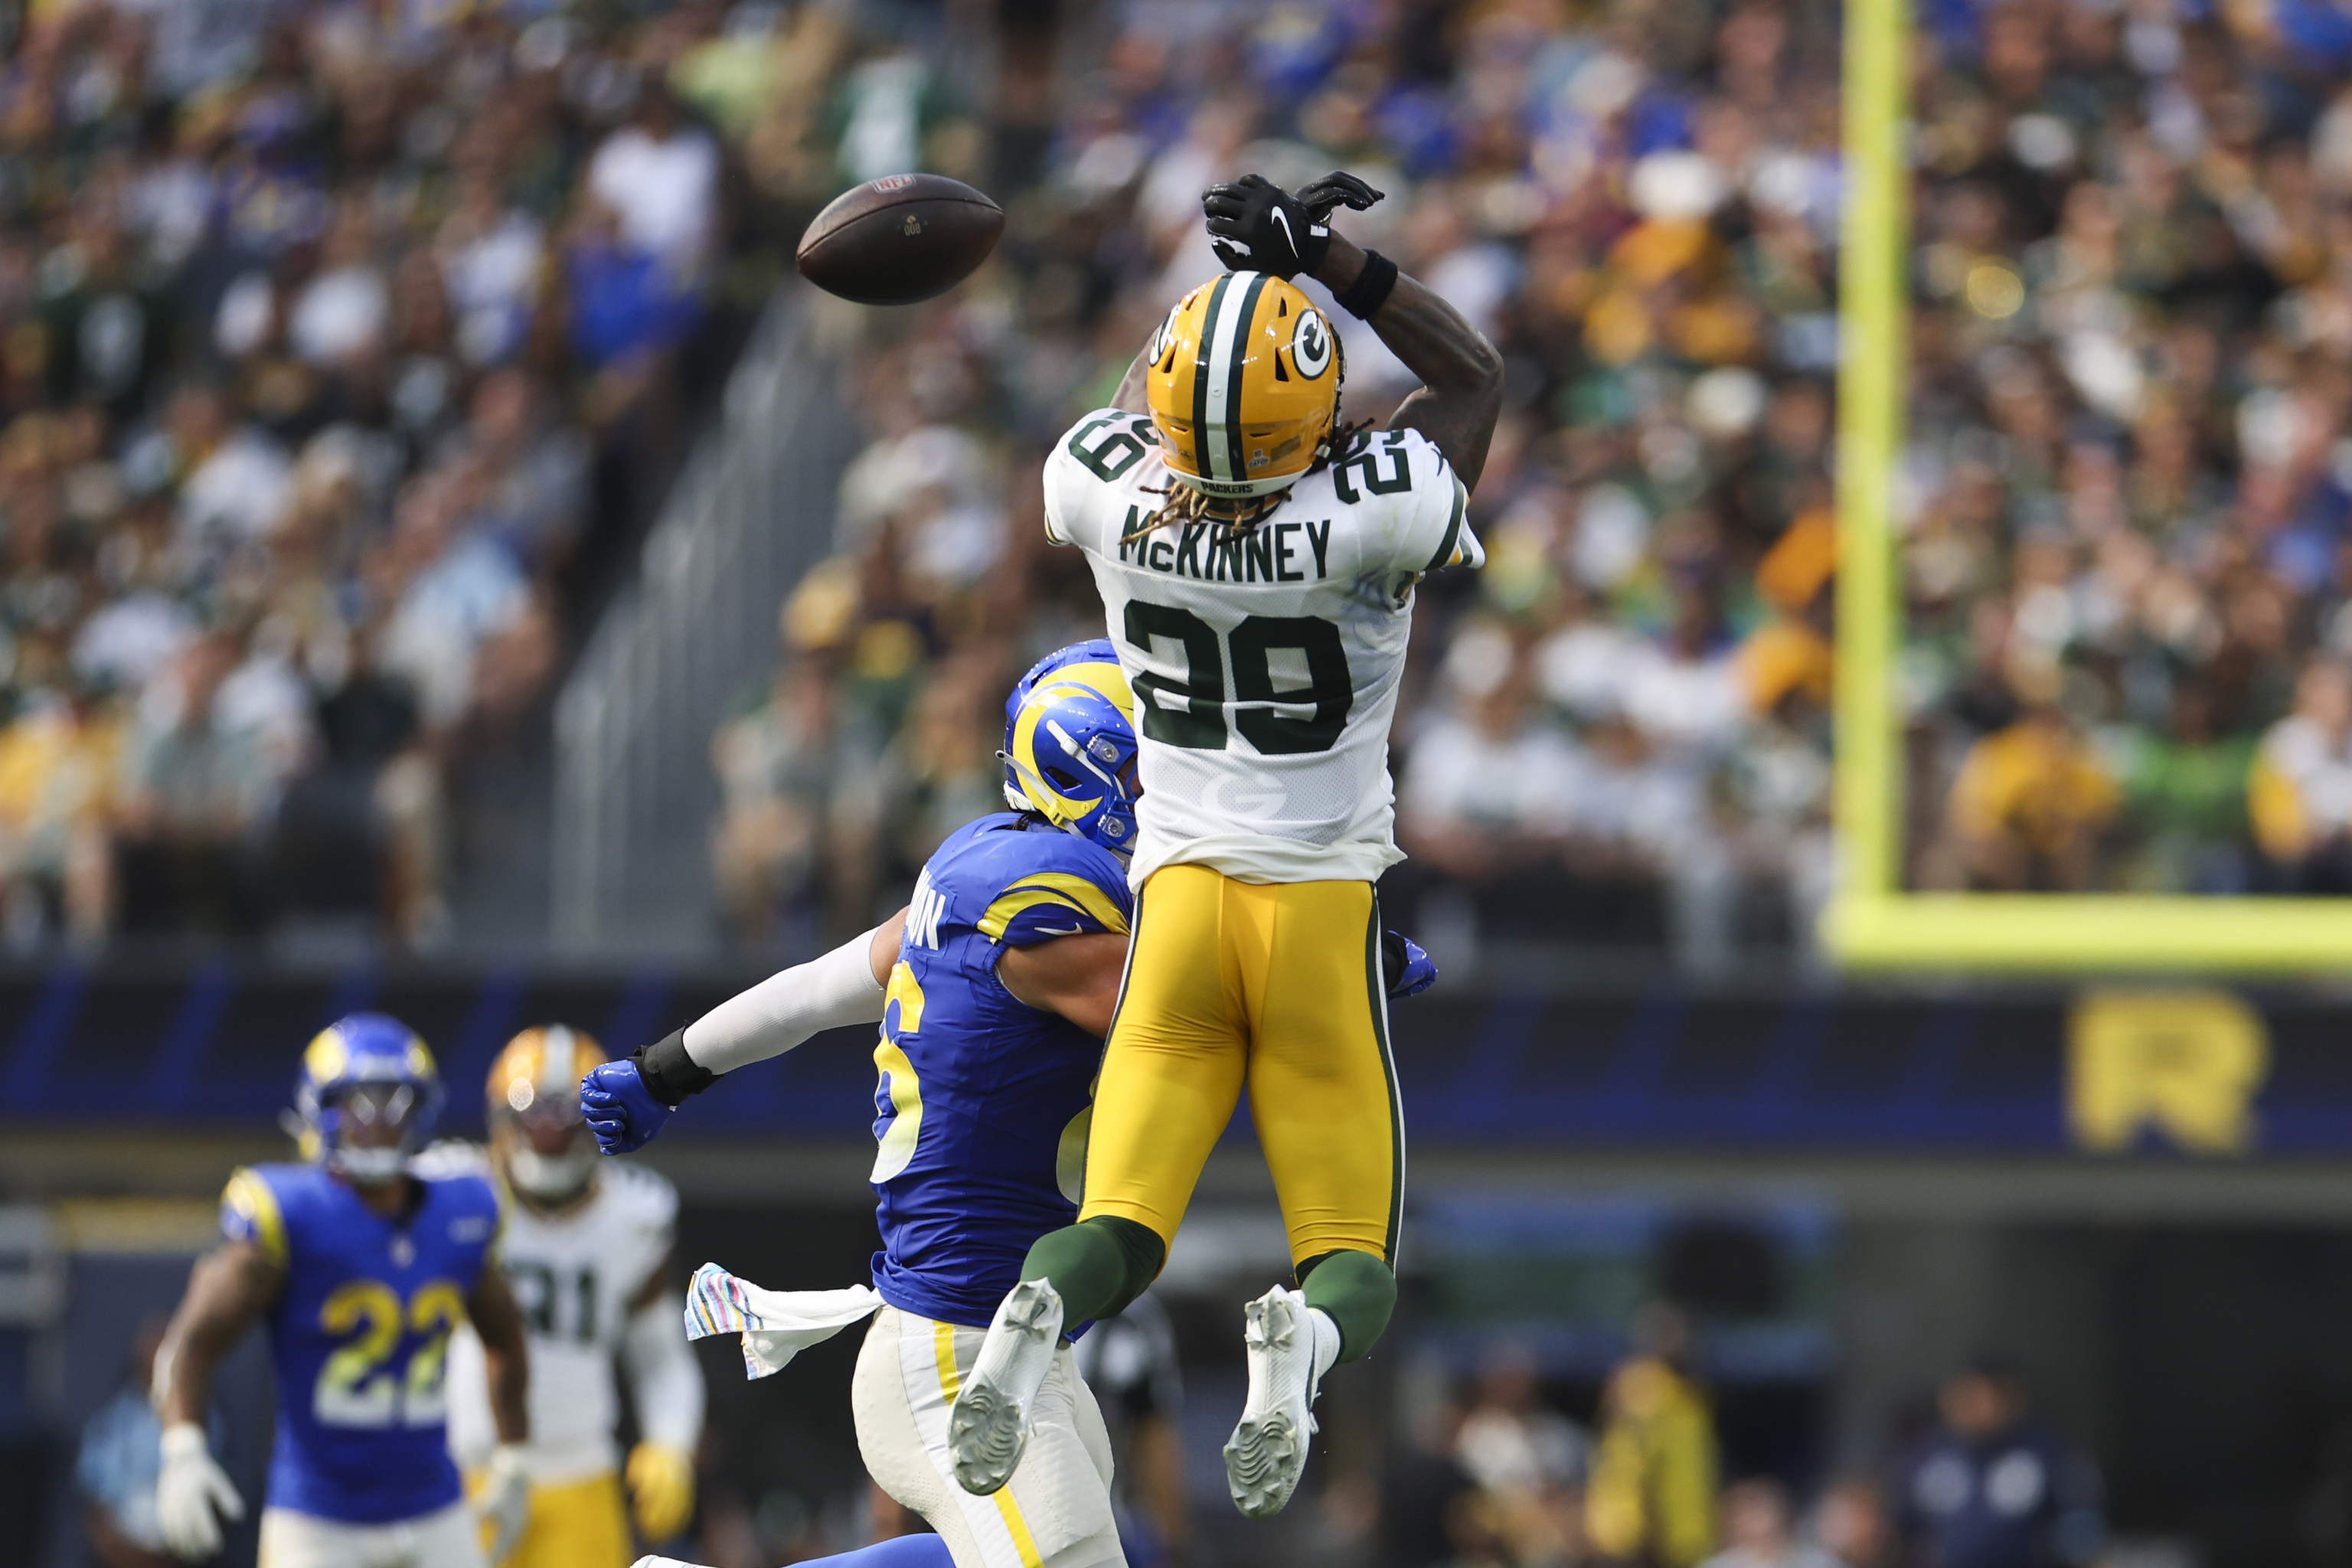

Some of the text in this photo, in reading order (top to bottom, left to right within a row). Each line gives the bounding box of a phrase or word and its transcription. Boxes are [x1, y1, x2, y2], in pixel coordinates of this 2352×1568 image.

[877, 178, 912, 190] NFL
[1119, 505, 1331, 582] McKINNEY
[1200, 481, 1254, 494] PACKERS
[1124, 599, 1354, 755] 29
[2066, 992, 2269, 1155] R
[313, 1280, 467, 1429] 22
